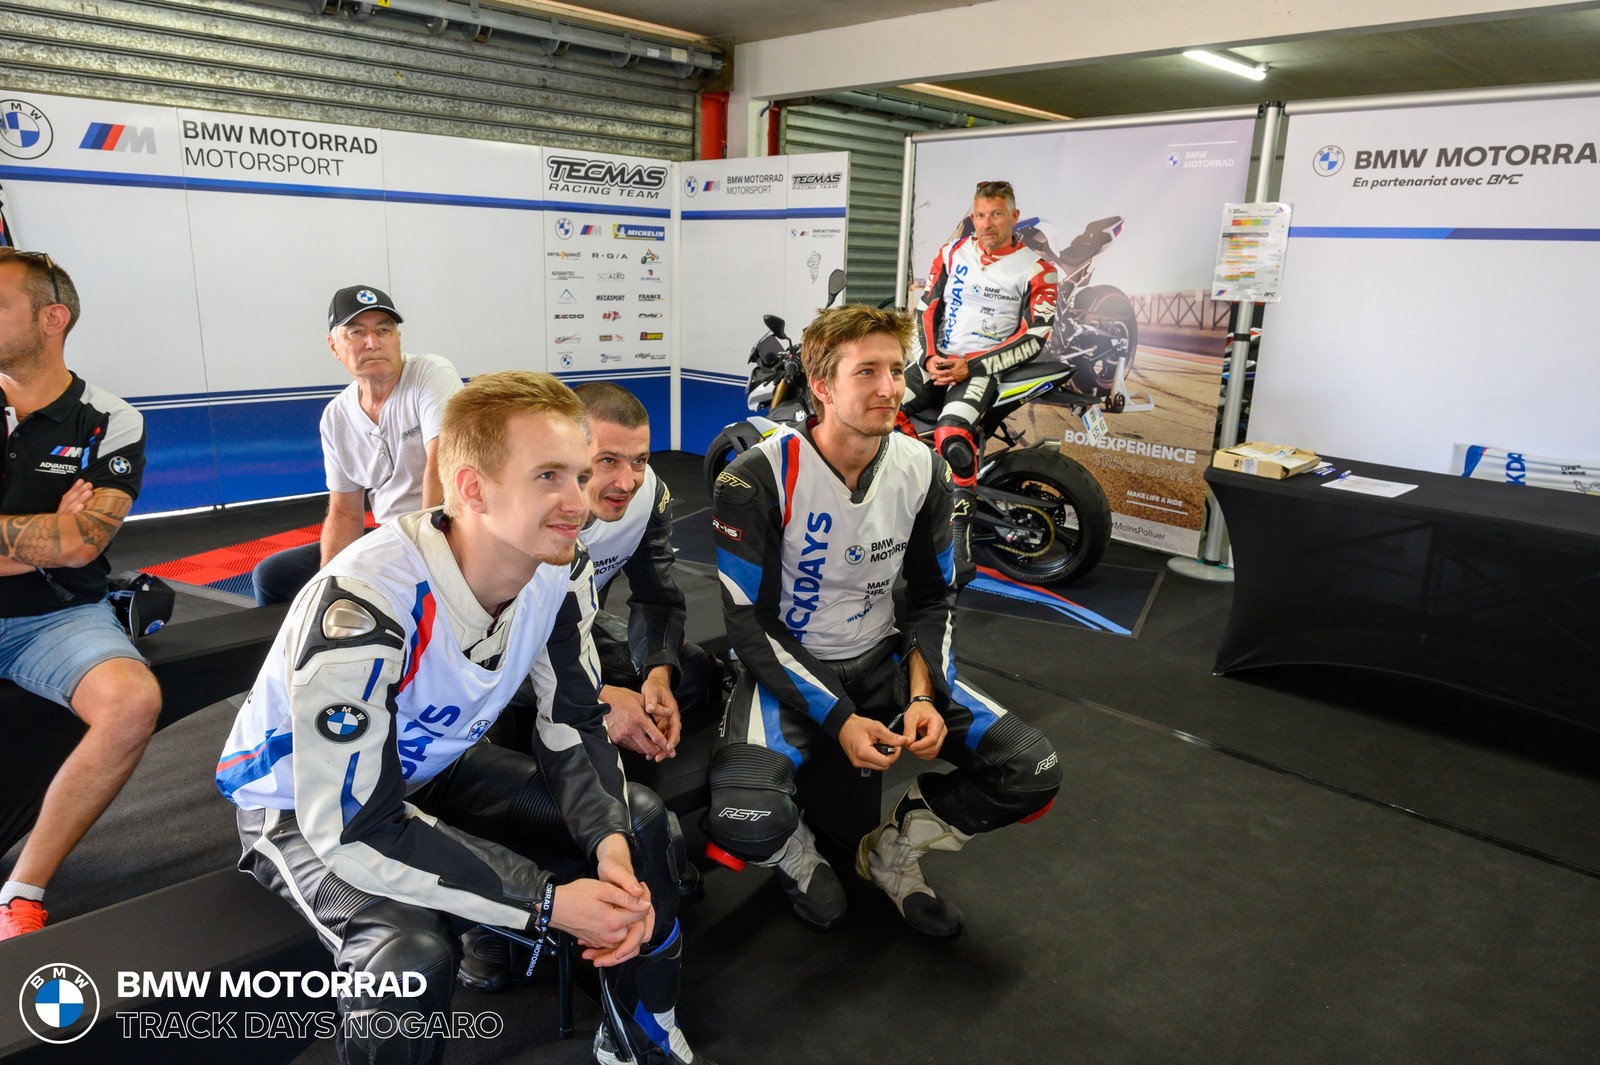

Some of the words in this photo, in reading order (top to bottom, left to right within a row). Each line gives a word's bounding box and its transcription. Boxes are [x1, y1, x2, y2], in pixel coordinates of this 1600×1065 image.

[183, 119, 244, 144] BMW
[250, 126, 378, 155] MOTORRAD
[185, 146, 344, 176] MOTORSPORT
[1185, 151, 1208, 159] BMW
[1354, 149, 1428, 170] BMW
[1436, 142, 1600, 168] MOTORRA
[1183, 159, 1234, 168] MOTORRAD
[548, 158, 666, 188] TECMAS
[727, 175, 743, 184] BMW
[744, 174, 784, 184] MOTORRAD
[793, 174, 842, 185] TECMAS
[727, 185, 772, 195] MOTORSPORT
[1352, 177, 1368, 188] En
[1371, 175, 1447, 190] partenariat
[1450, 176, 1483, 187] avec
[548, 183, 611, 196] RACING
[619, 188, 659, 199] TEAM
[627, 229, 664, 238] MICHELIN
[983, 293, 1019, 302] MOTORRAD
[981, 338, 1041, 375] YAMAHA
[40, 462, 78, 472] ADVANTEC
[1093, 452, 1144, 475] TRACK
[1126, 490, 1146, 500] MAKE
[1147, 494, 1160, 502] LIFE
[1167, 498, 1183, 507] RIDE
[871, 537, 894, 552] BMW
[867, 578, 891, 590] MAKE
[718, 807, 771, 822] RST
[543, 883, 553, 910] ORRAD
